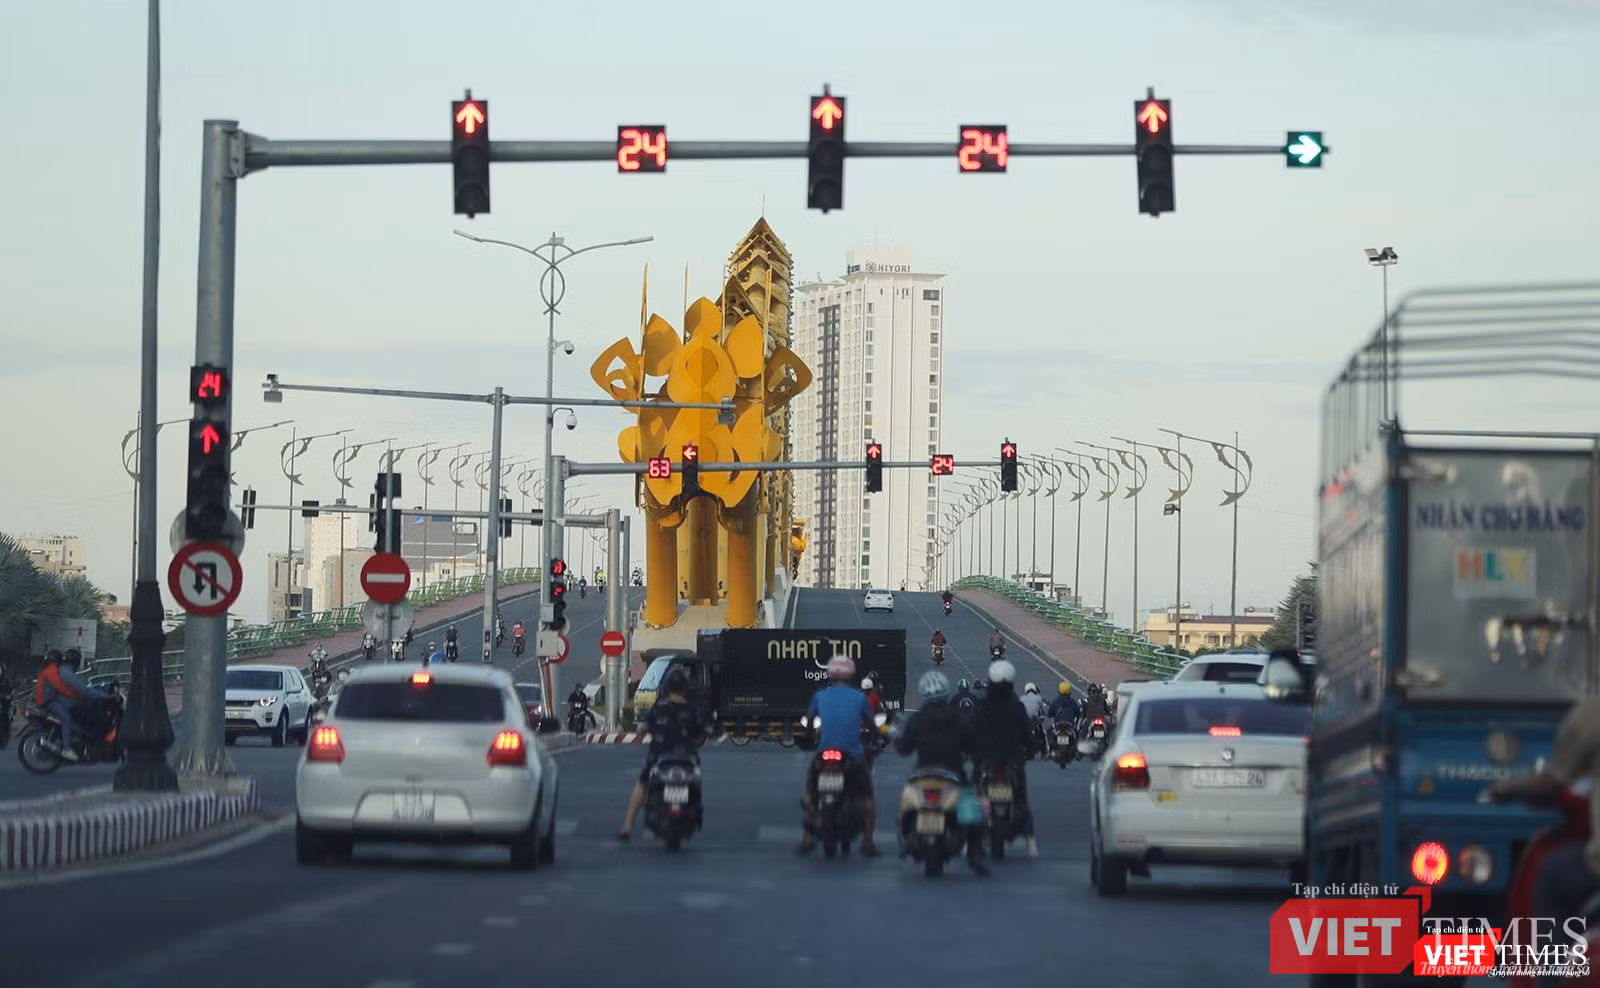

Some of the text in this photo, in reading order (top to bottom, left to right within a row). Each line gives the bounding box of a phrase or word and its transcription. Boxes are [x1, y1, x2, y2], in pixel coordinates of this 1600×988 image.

[619, 129, 666, 170] 24
[959, 129, 1007, 170] 24
[878, 264, 911, 273] HIYORI
[198, 371, 222, 399] 24
[650, 459, 670, 477] 63
[932, 457, 953, 474] 24
[768, 640, 861, 659] NHAT TIN
